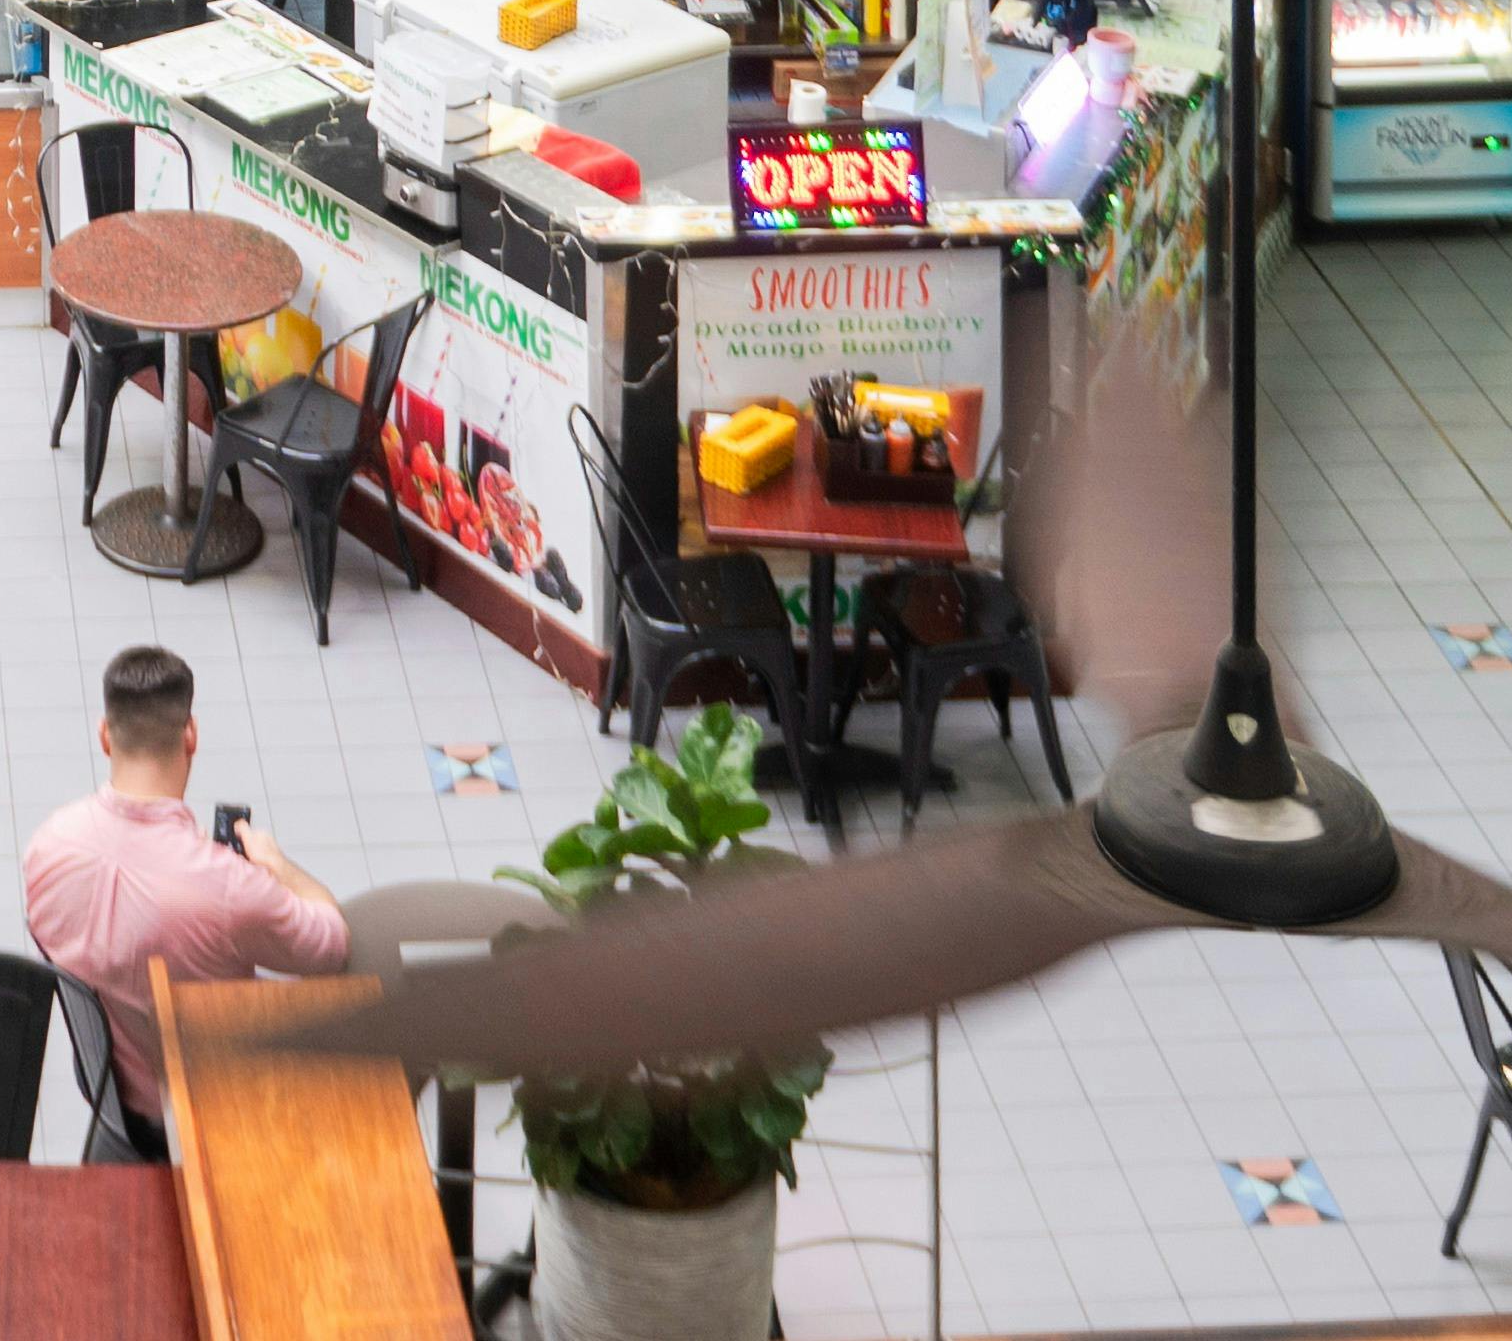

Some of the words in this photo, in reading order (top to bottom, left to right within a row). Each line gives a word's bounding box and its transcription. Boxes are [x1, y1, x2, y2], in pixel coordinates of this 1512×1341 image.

[63, 41, 172, 137] MEKONG
[231, 140, 351, 243] MEKONG
[750, 149, 914, 207] OPEN
[420, 251, 553, 364] MEKONG
[748, 262, 932, 314] SMOOTHIES
[695, 316, 822, 340] Avocado
[837, 313, 985, 335] Blueberry
[725, 340, 825, 359] Mango
[840, 337, 953, 355] Banana
